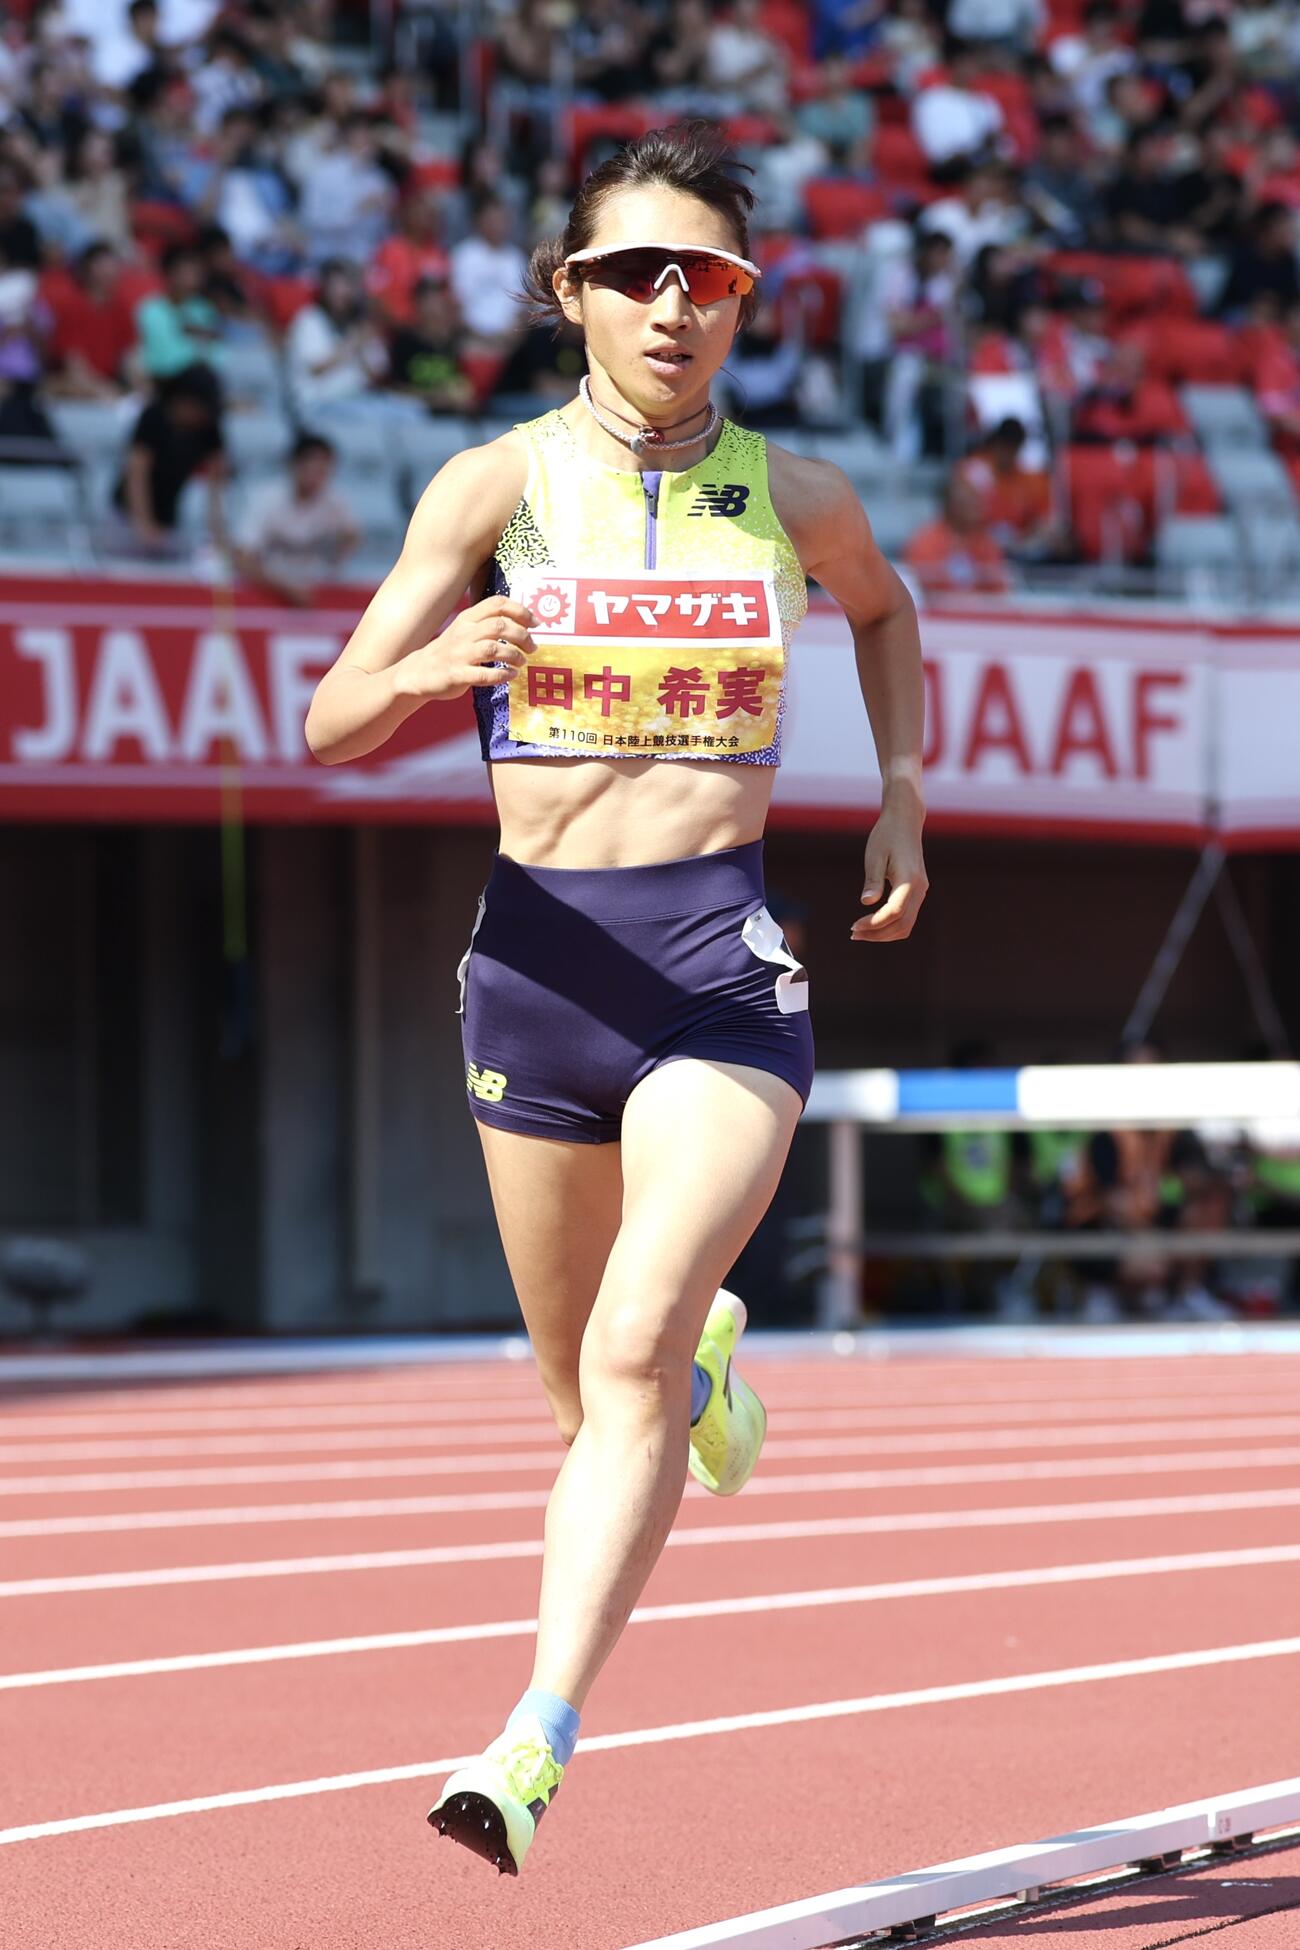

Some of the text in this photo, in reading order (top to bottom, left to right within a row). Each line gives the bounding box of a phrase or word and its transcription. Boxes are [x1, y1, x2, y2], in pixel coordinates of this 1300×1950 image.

[687, 484, 750, 517] NB
[587, 591, 758, 627] ヤマザキ
[527, 665, 766, 719] 田中 希実
[548, 727, 740, 748] 第110回 日本陸上競技選手権大会
[466, 1062, 508, 1103] NB
